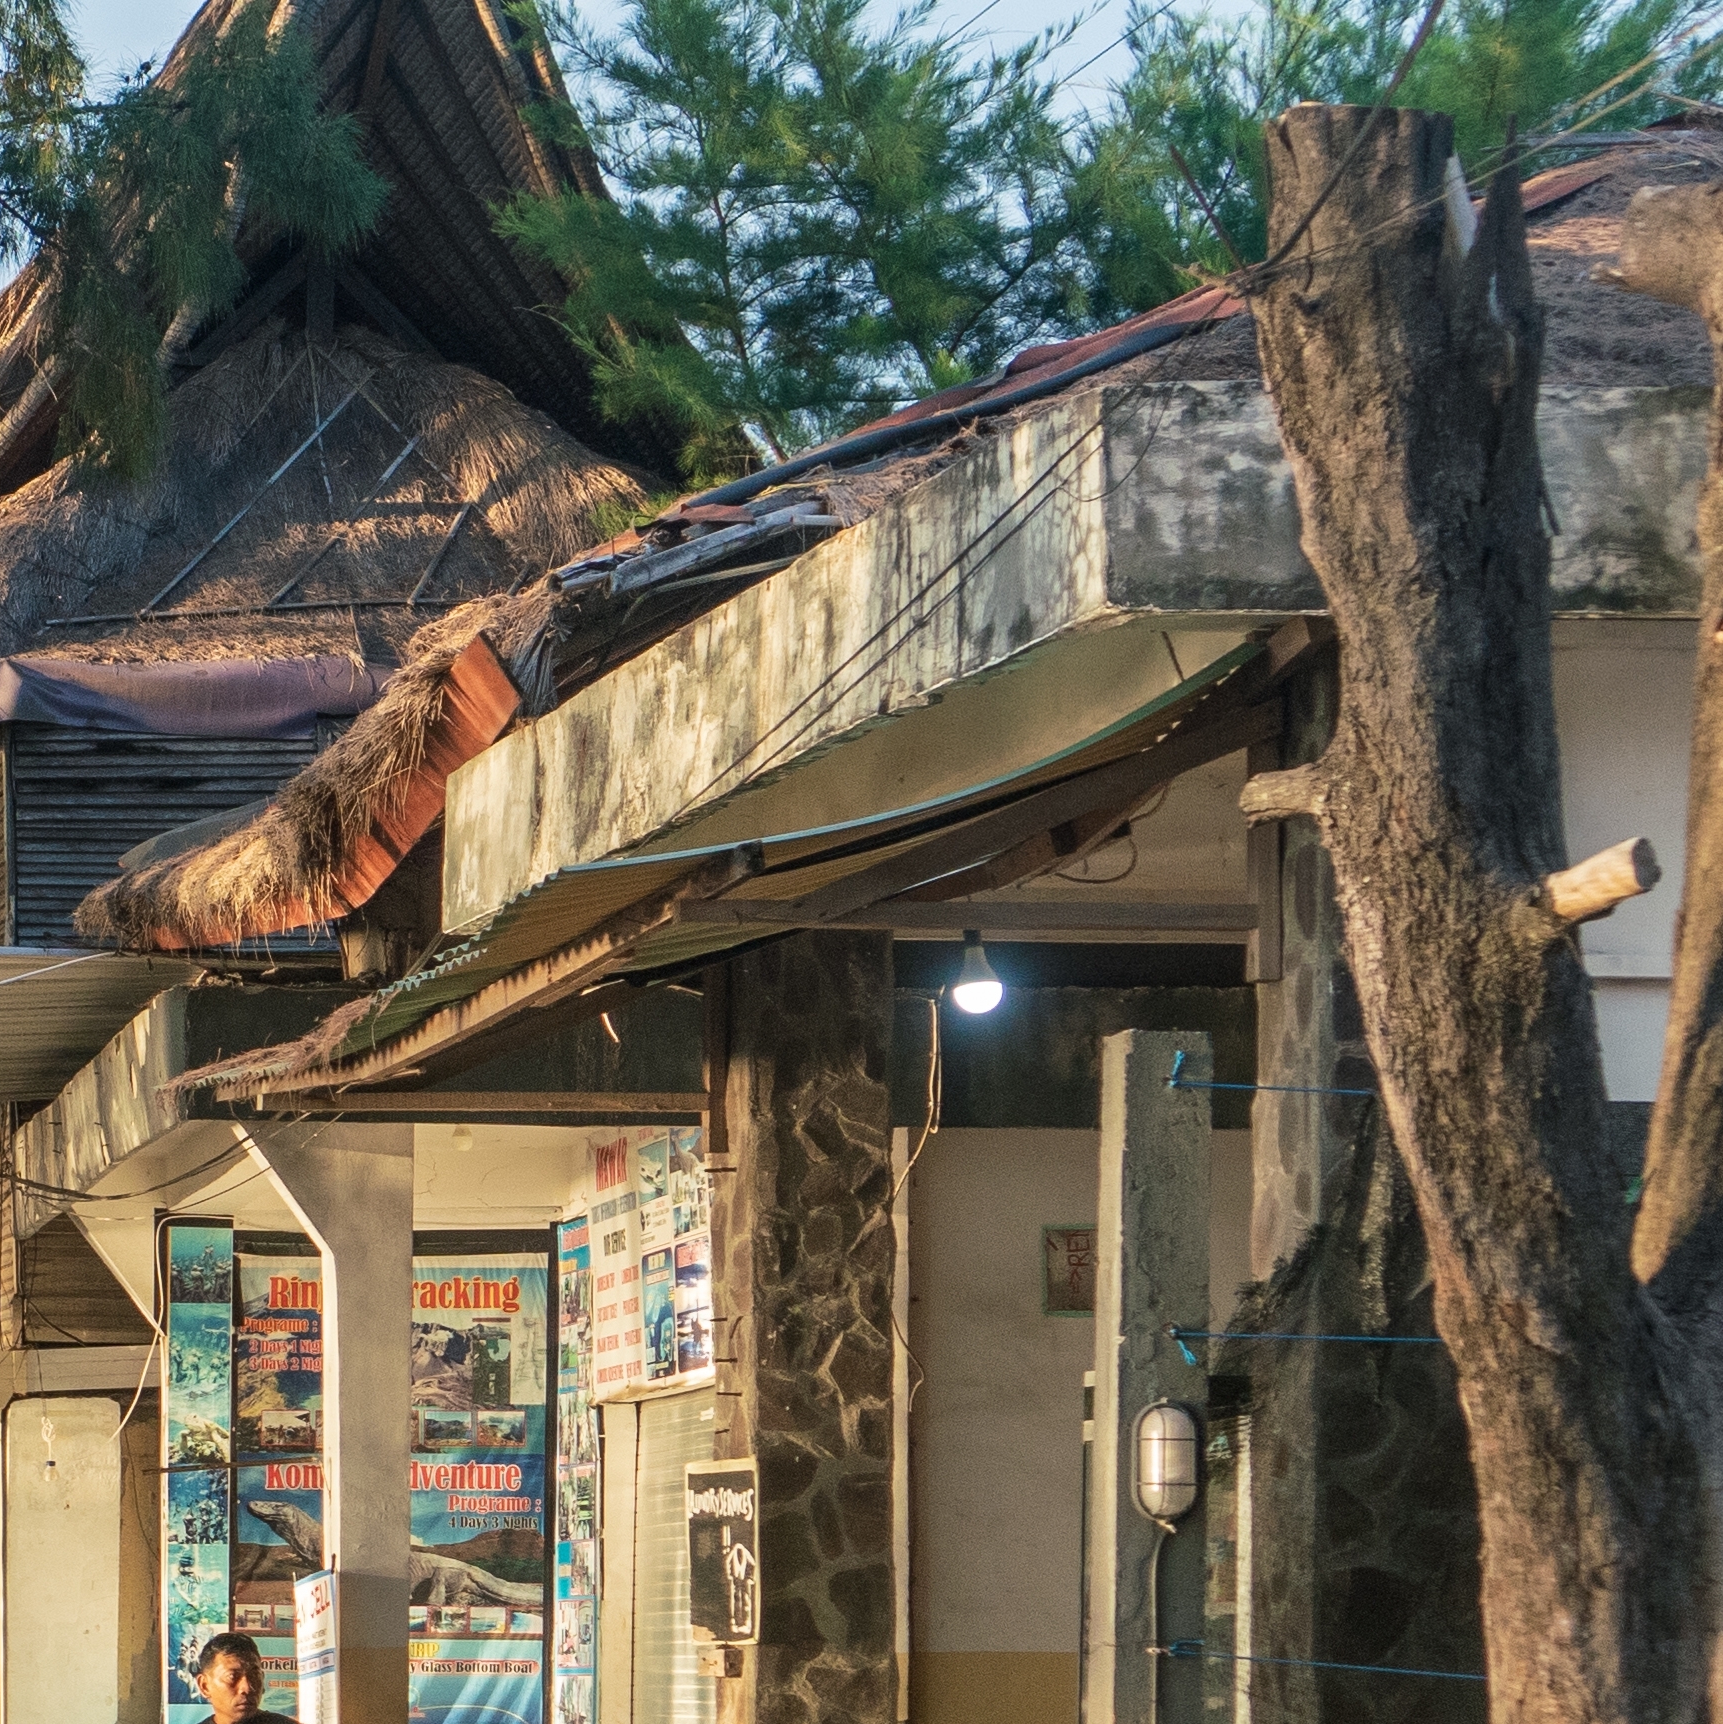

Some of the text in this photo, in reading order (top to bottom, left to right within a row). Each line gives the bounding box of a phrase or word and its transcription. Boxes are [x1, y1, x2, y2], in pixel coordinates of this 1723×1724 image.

[240, 1318, 309, 1335] Programe
[261, 1340, 289, 1354] Days
[260, 1357, 289, 1371] Days
[447, 1494, 531, 1514] Programe
[448, 1515, 538, 1530] 4 Days 3 Nights
[421, 1660, 452, 1674] Glass
[455, 1660, 500, 1674] Bottom
[505, 1660, 533, 1674] Boat
